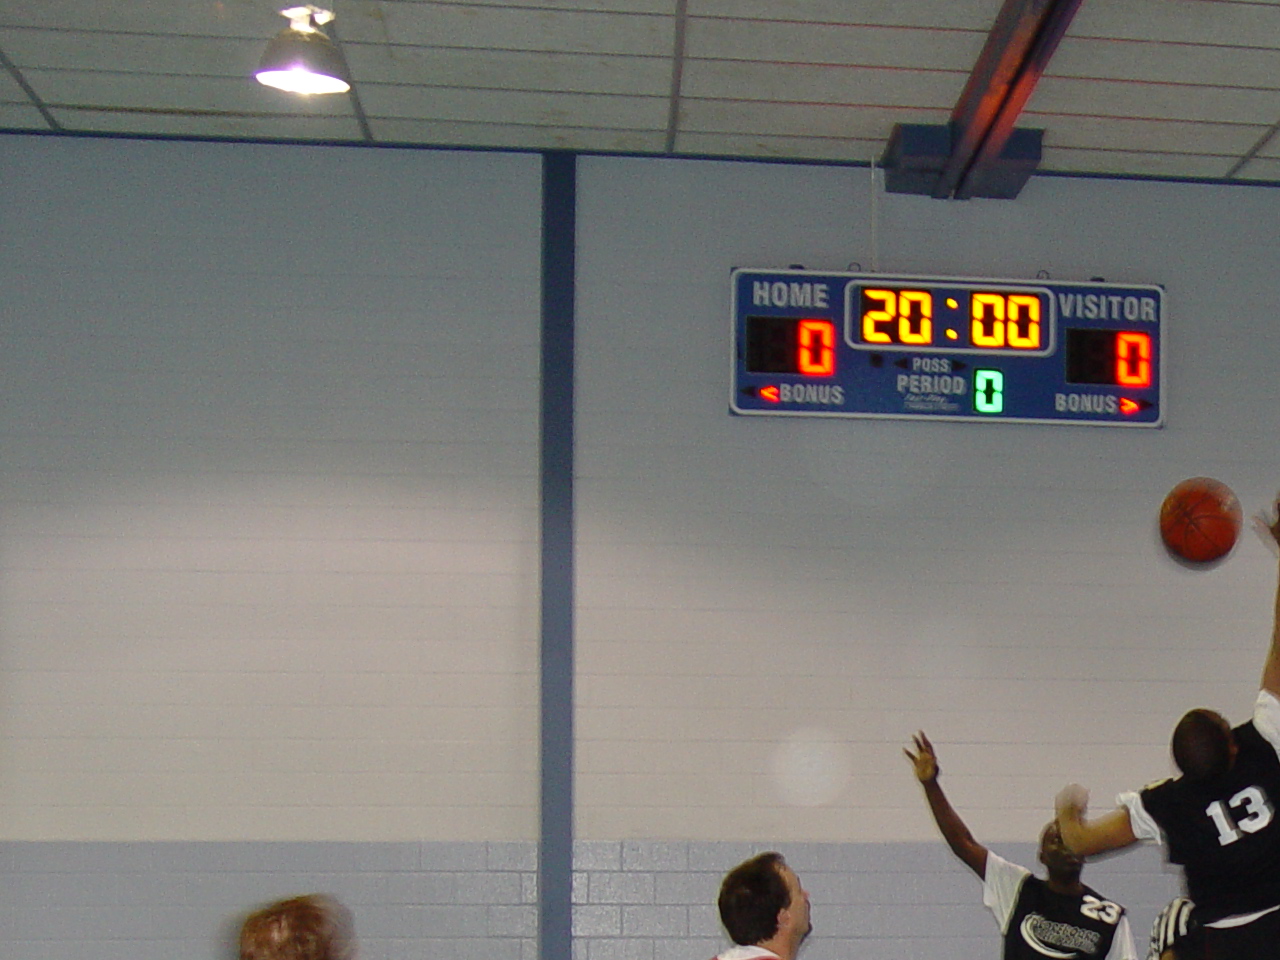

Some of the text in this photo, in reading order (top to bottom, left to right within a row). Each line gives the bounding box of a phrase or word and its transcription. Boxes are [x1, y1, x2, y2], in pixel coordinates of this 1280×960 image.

[752, 281, 830, 309] HOME
[1058, 293, 1158, 322] VISITOR
[861, 287, 1042, 349] 20:00
[797, 319, 836, 377] 0
[1114, 331, 1153, 388] 0
[911, 356, 951, 373] POSS
[779, 384, 845, 405] BONUS
[896, 374, 966, 395] PERIOD
[974, 368, 1004, 413] 0
[1055, 394, 1118, 414] BONUS
[1205, 785, 1273, 846] 13
[1080, 894, 1122, 925] 23
